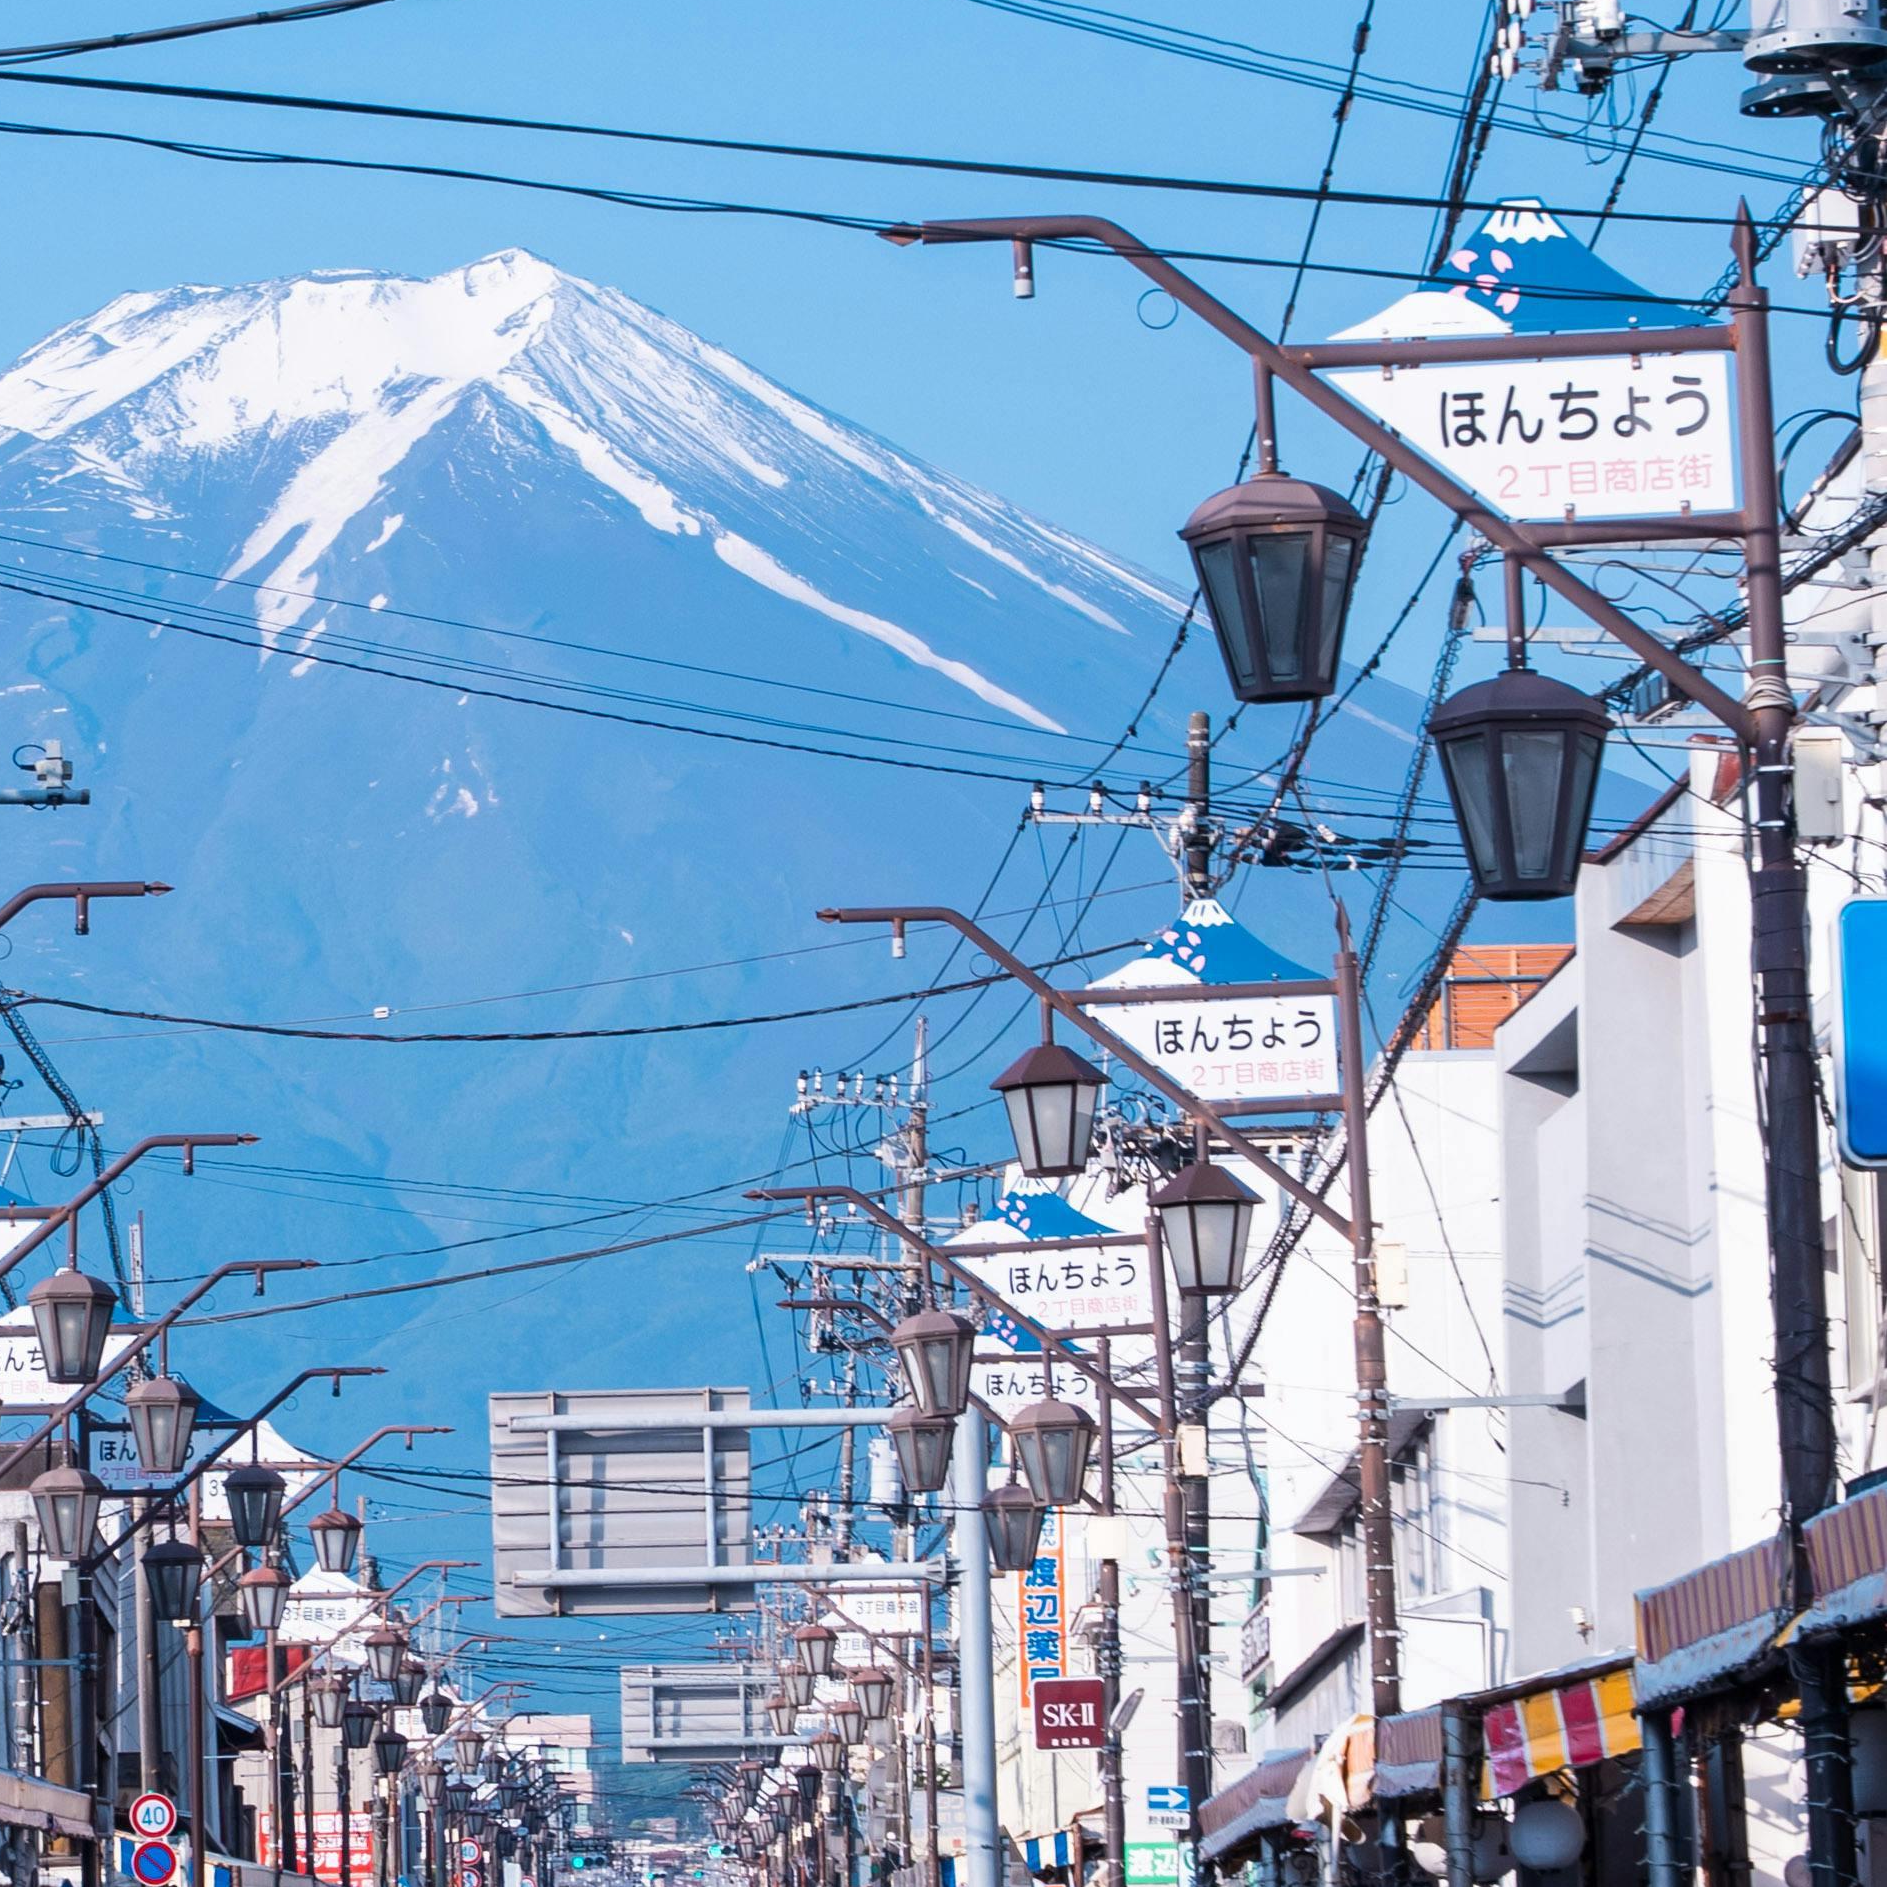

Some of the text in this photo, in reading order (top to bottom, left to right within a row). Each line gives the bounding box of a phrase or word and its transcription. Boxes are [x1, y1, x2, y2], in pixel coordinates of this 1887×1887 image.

[1439, 374, 1712, 448] ほんちょう
[1154, 1009, 1323, 1056] ほんちょう
[1007, 1256, 1138, 1295] ほんちょう
[141, 1805, 167, 1828] 40
